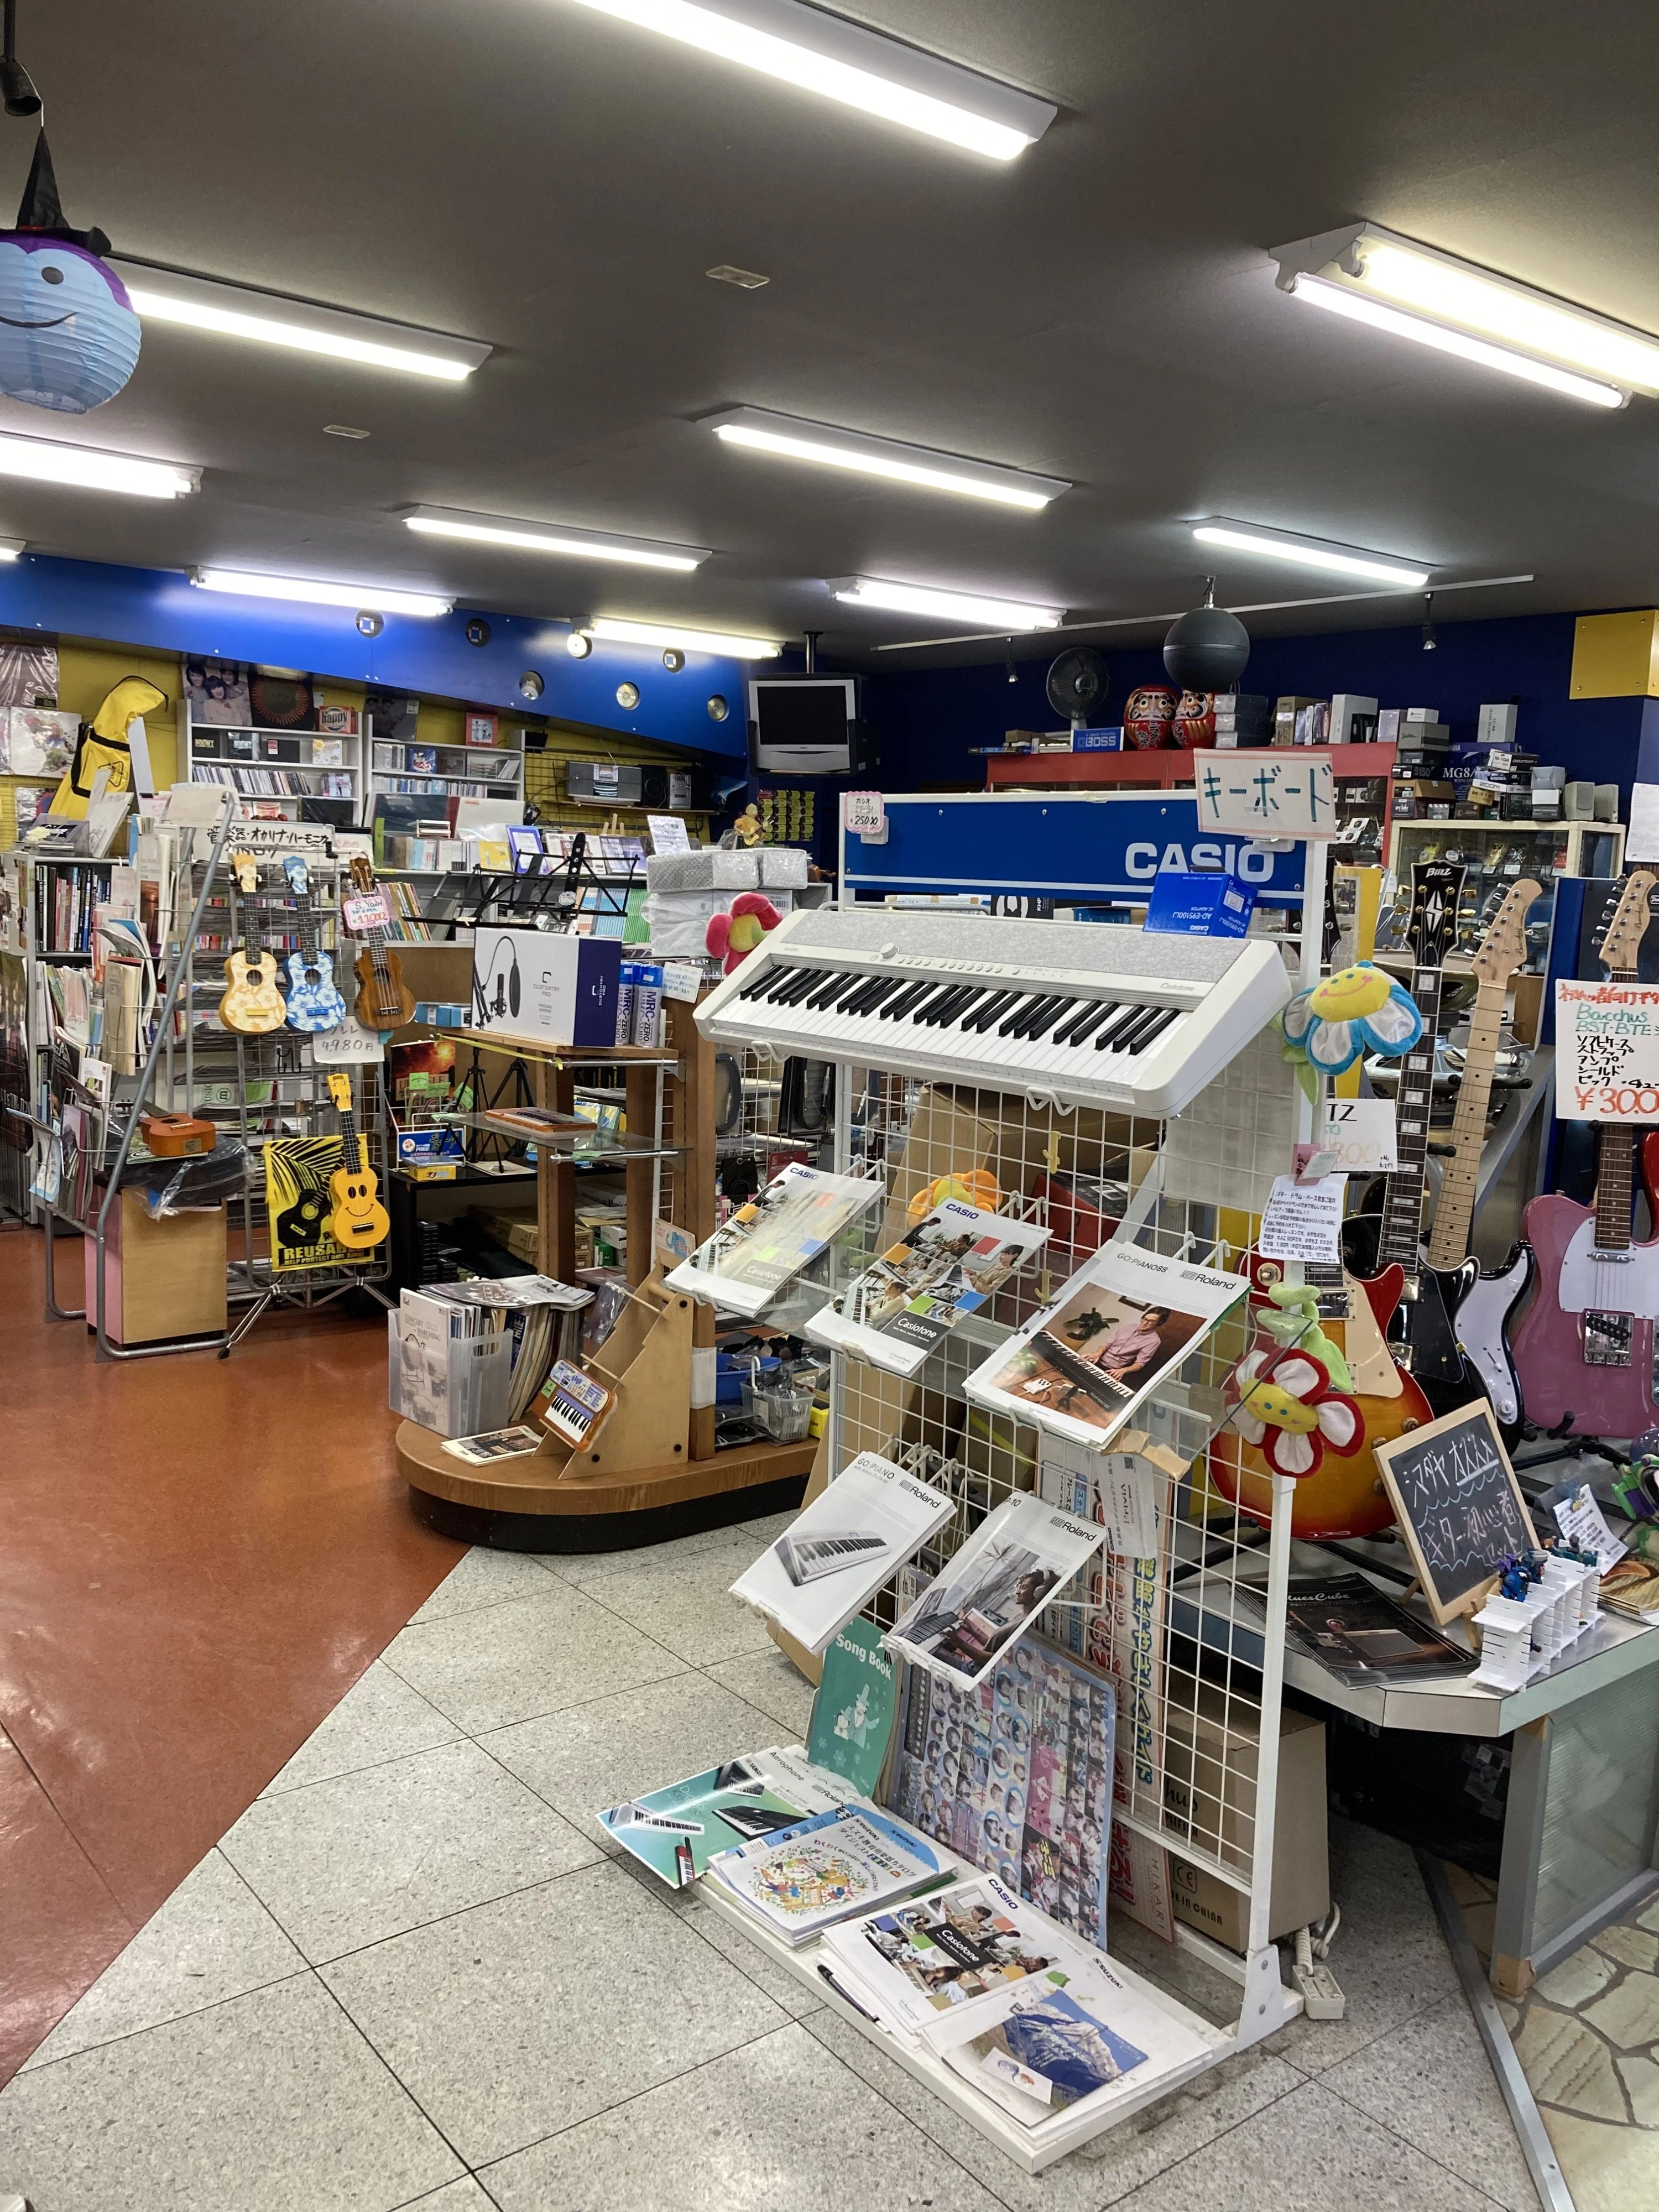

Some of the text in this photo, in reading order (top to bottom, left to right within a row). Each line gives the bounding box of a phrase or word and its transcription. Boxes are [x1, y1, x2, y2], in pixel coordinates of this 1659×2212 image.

[321, 710, 347, 725] happy
[1086, 736, 1116, 747] BOSS
[1413, 766, 1431, 778] 5150
[1203, 764, 1333, 822] キーボード
[1125, 842, 1275, 882] CASIO
[621, 988, 632, 1039] MRC-ZERO
[643, 991, 656, 1042] MRC-ZERO
[1576, 1003, 1648, 1022] Bacchus
[1577, 1055, 1620, 1066] アンプ
[1578, 1065, 1624, 1076] シールド
[1578, 1075, 1611, 1087] ピック
[1574, 1086, 1659, 1115] ¥30,0
[1327, 1103, 1358, 1121] TZ
[790, 1167, 819, 1180] CASIO
[946, 1203, 979, 1219] CASIO
[284, 1241, 364, 1260] REUSAB
[301, 1255, 330, 1264] PROTECT
[747, 1265, 781, 1280] Casiotone
[1117, 1253, 1237, 1290] GO:PIANO88 Roland
[898, 1317, 937, 1338] Casiotone
[858, 1458, 895, 1479] GO:PIANO
[909, 1485, 941, 1509] Roland
[1004, 1497, 1021, 1507] P-10
[1061, 1522, 1097, 1541] Roland
[835, 1632, 891, 1681] Song Book
[769, 1751, 805, 1782] Aerophone
[821, 1790, 846, 1806] Rolan
[859, 1822, 880, 1841] SUZUKI
[895, 1832, 919, 1848] SUZUKI
[988, 1878, 1019, 1910] CASIO
[1151, 1857, 1165, 1929] HIKARI
[1182, 1893, 1191, 1908] IN
[1193, 1903, 1223, 1926] CHINA
[942, 1929, 979, 1963] Casiotone
[1099, 1963, 1124, 1990] SUZUKI
